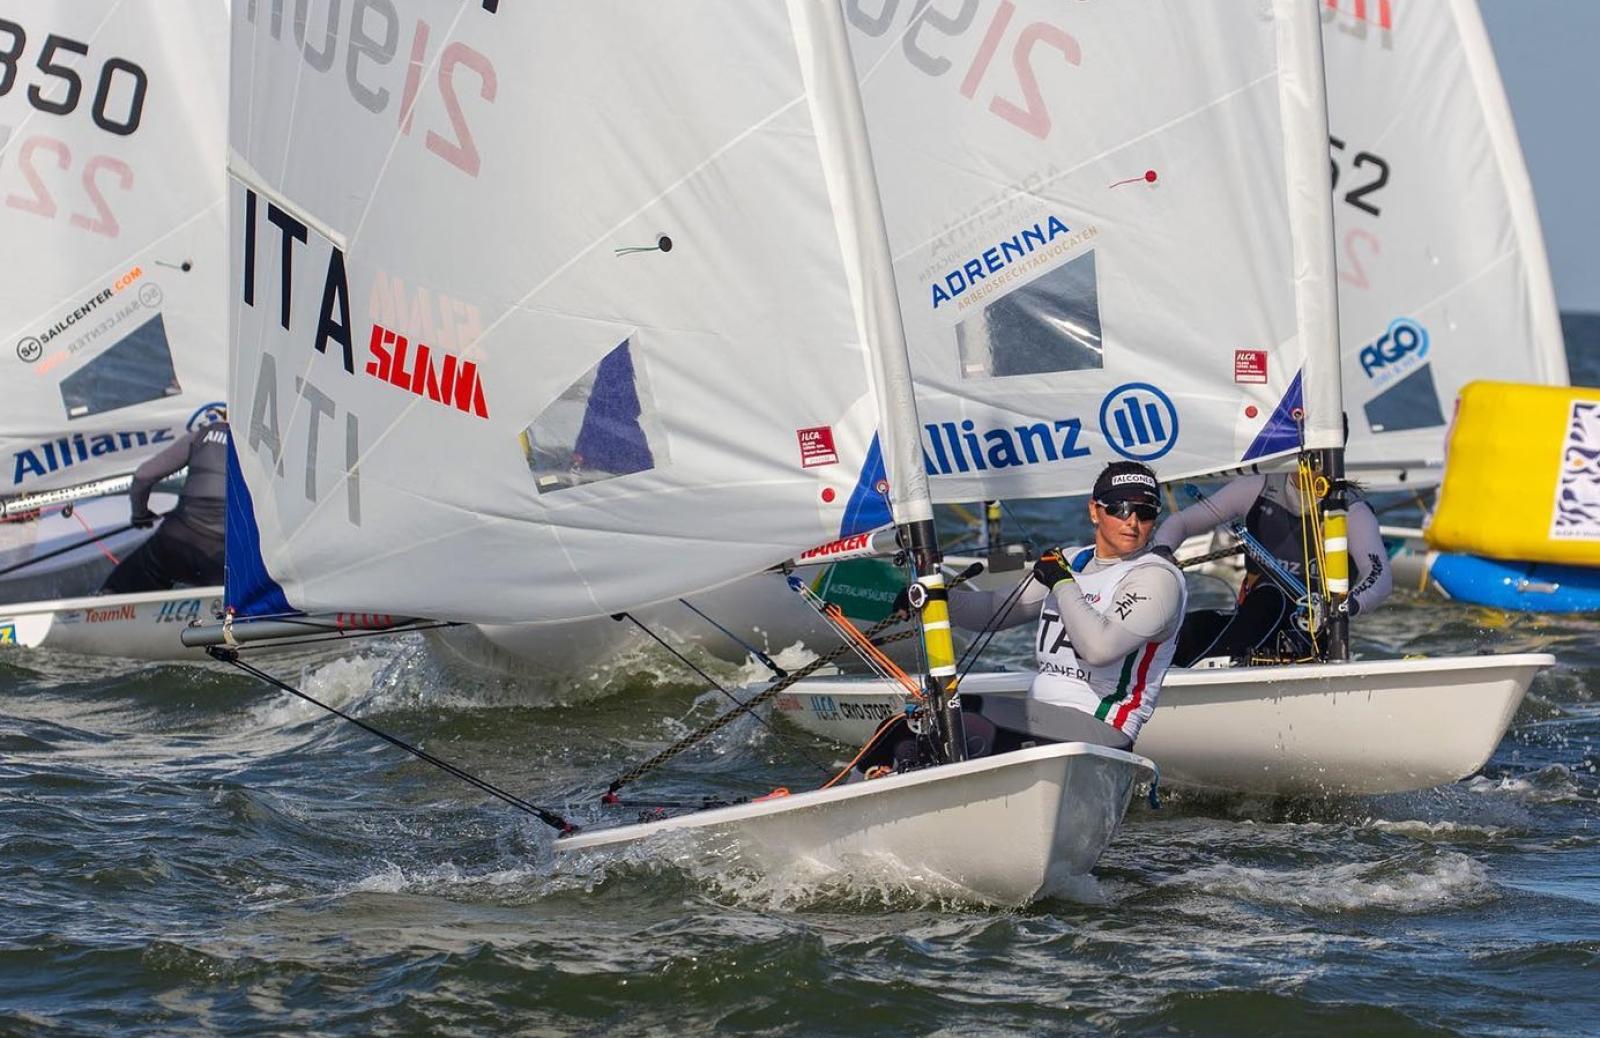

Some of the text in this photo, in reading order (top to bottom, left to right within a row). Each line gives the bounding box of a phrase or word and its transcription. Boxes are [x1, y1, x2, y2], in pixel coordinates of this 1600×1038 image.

[244, 188, 354, 375] ITA
[931, 214, 1070, 309] ADRENNA
[365, 323, 489, 420] SLAM
[13, 427, 175, 484] Allianz
[84, 605, 136, 623] TeamNL
[1114, 593, 1147, 620] zhik
